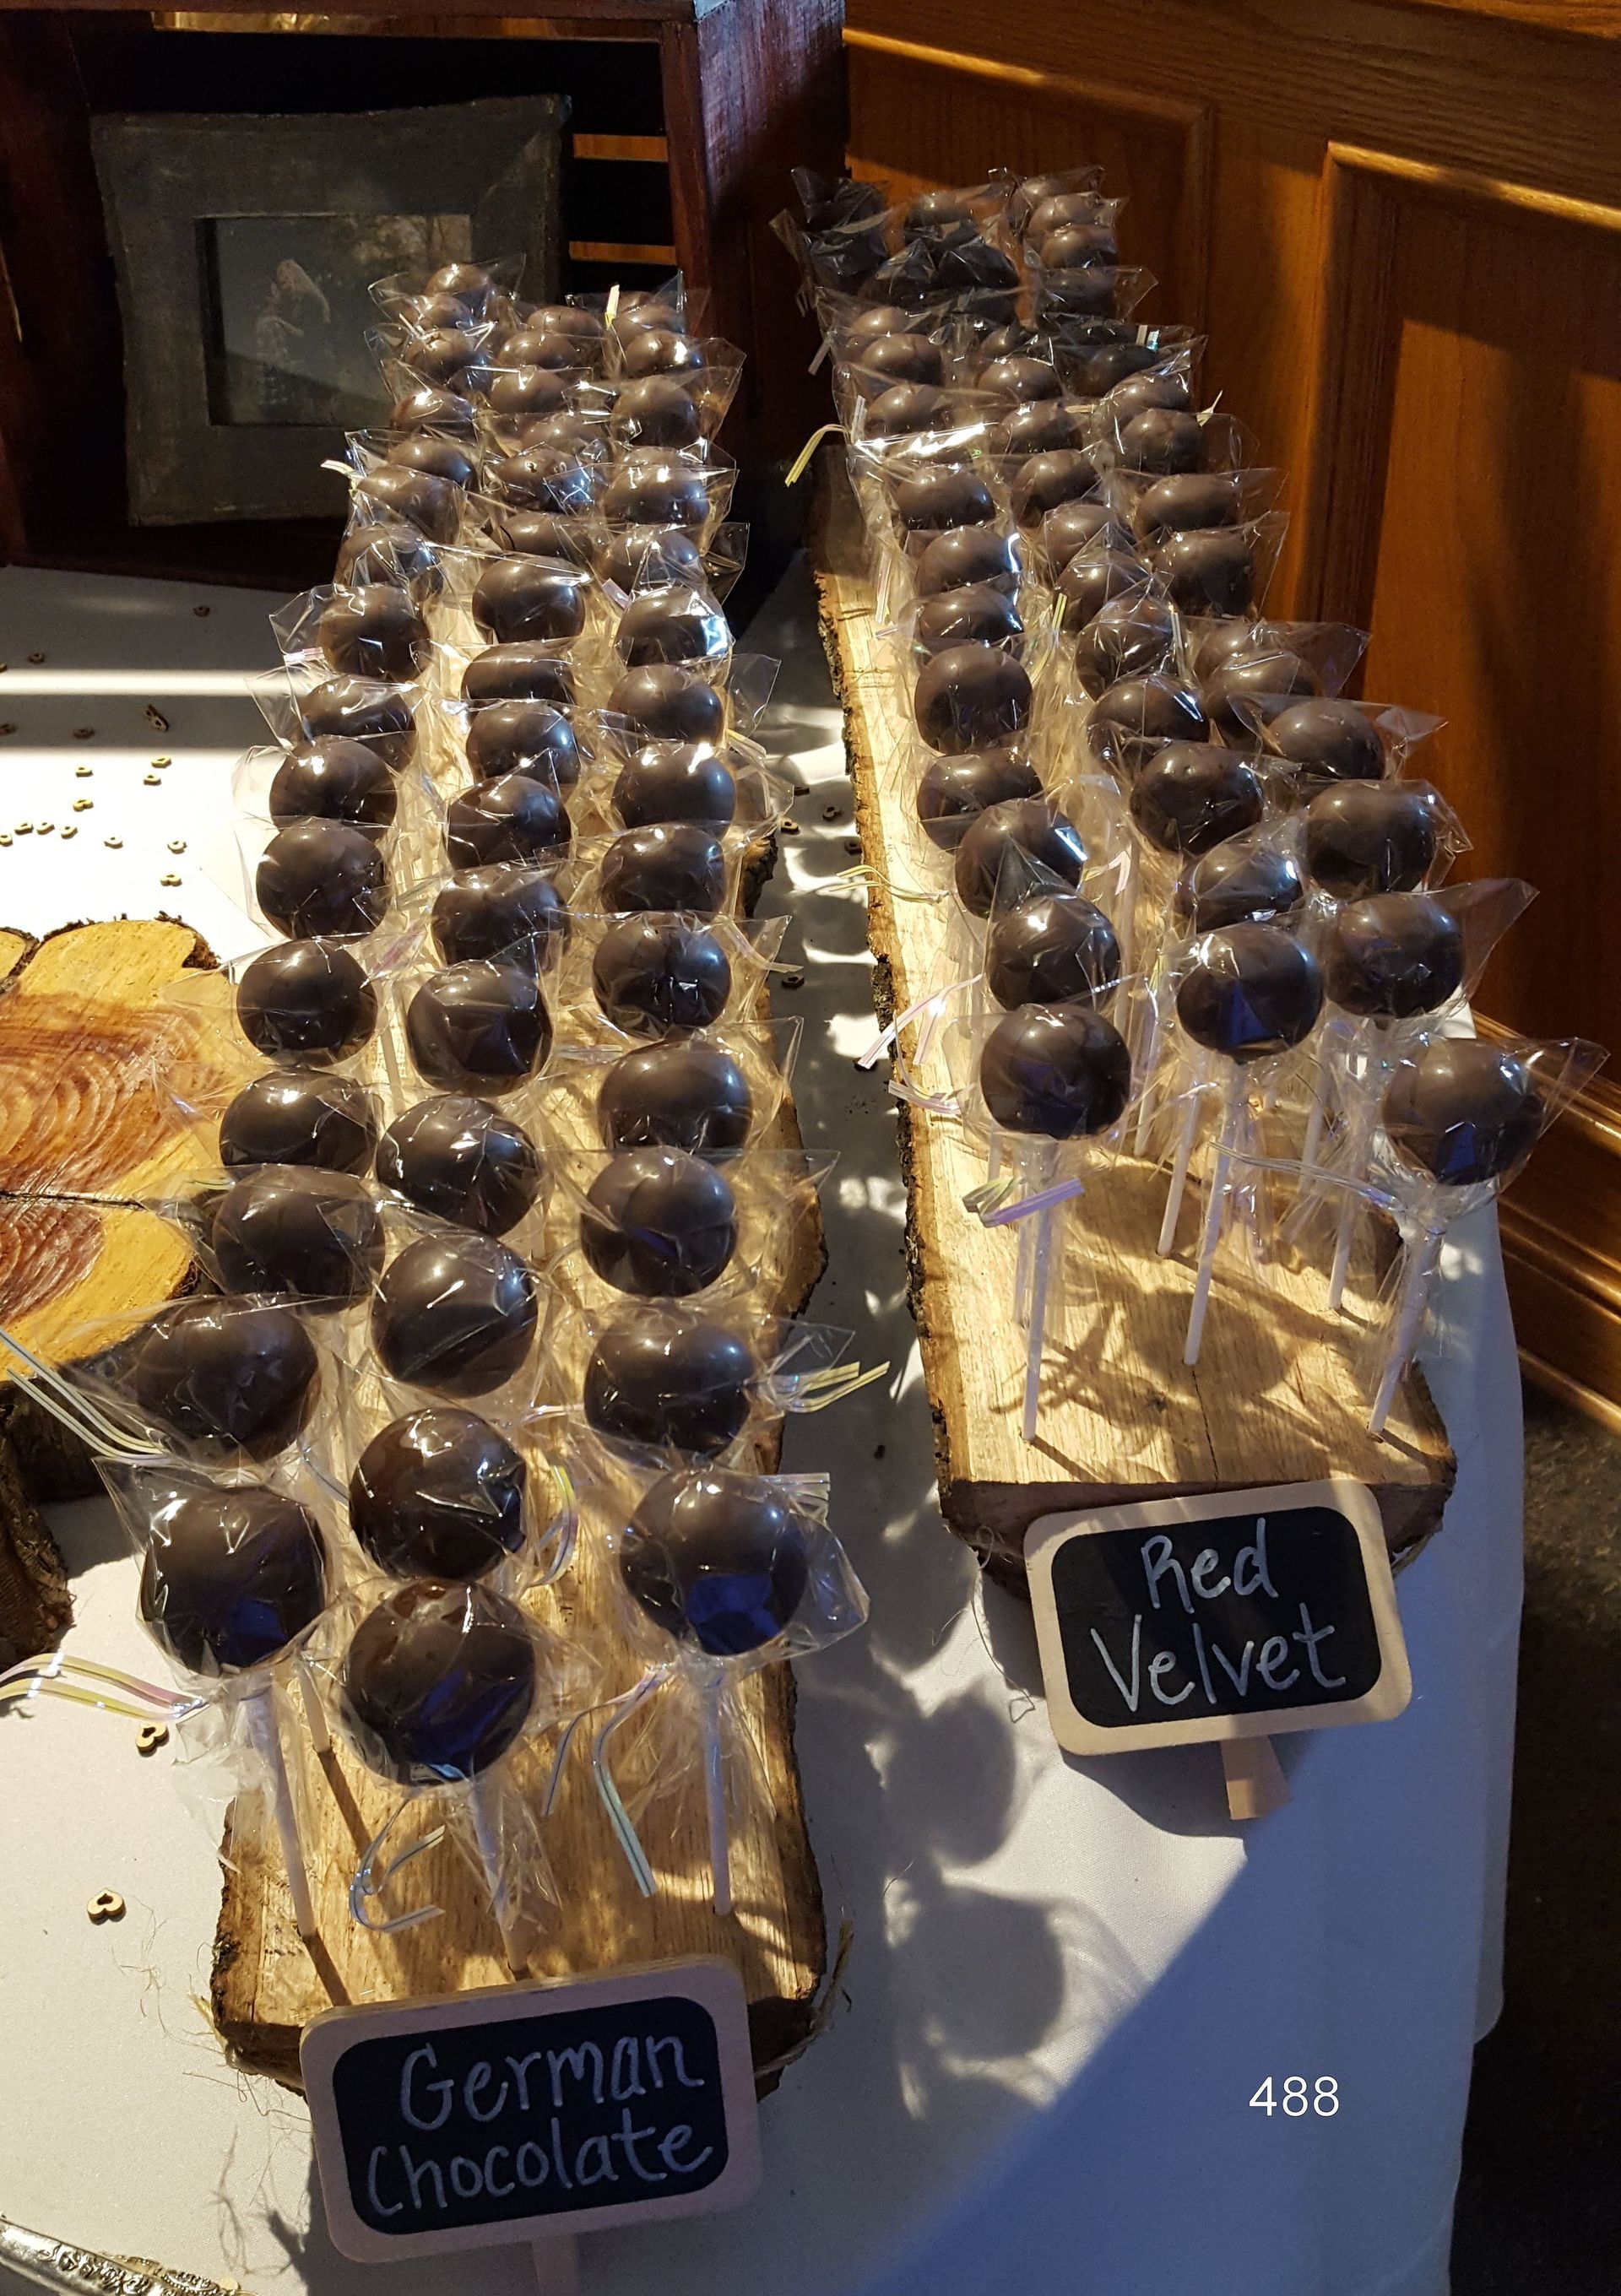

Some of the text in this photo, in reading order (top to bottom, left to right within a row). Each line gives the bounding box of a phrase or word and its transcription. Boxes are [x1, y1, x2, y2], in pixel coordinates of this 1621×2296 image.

[1141, 1518, 1278, 1614] Red
[1090, 1603, 1346, 1713] Velvet
[400, 2035, 705, 2131] German
